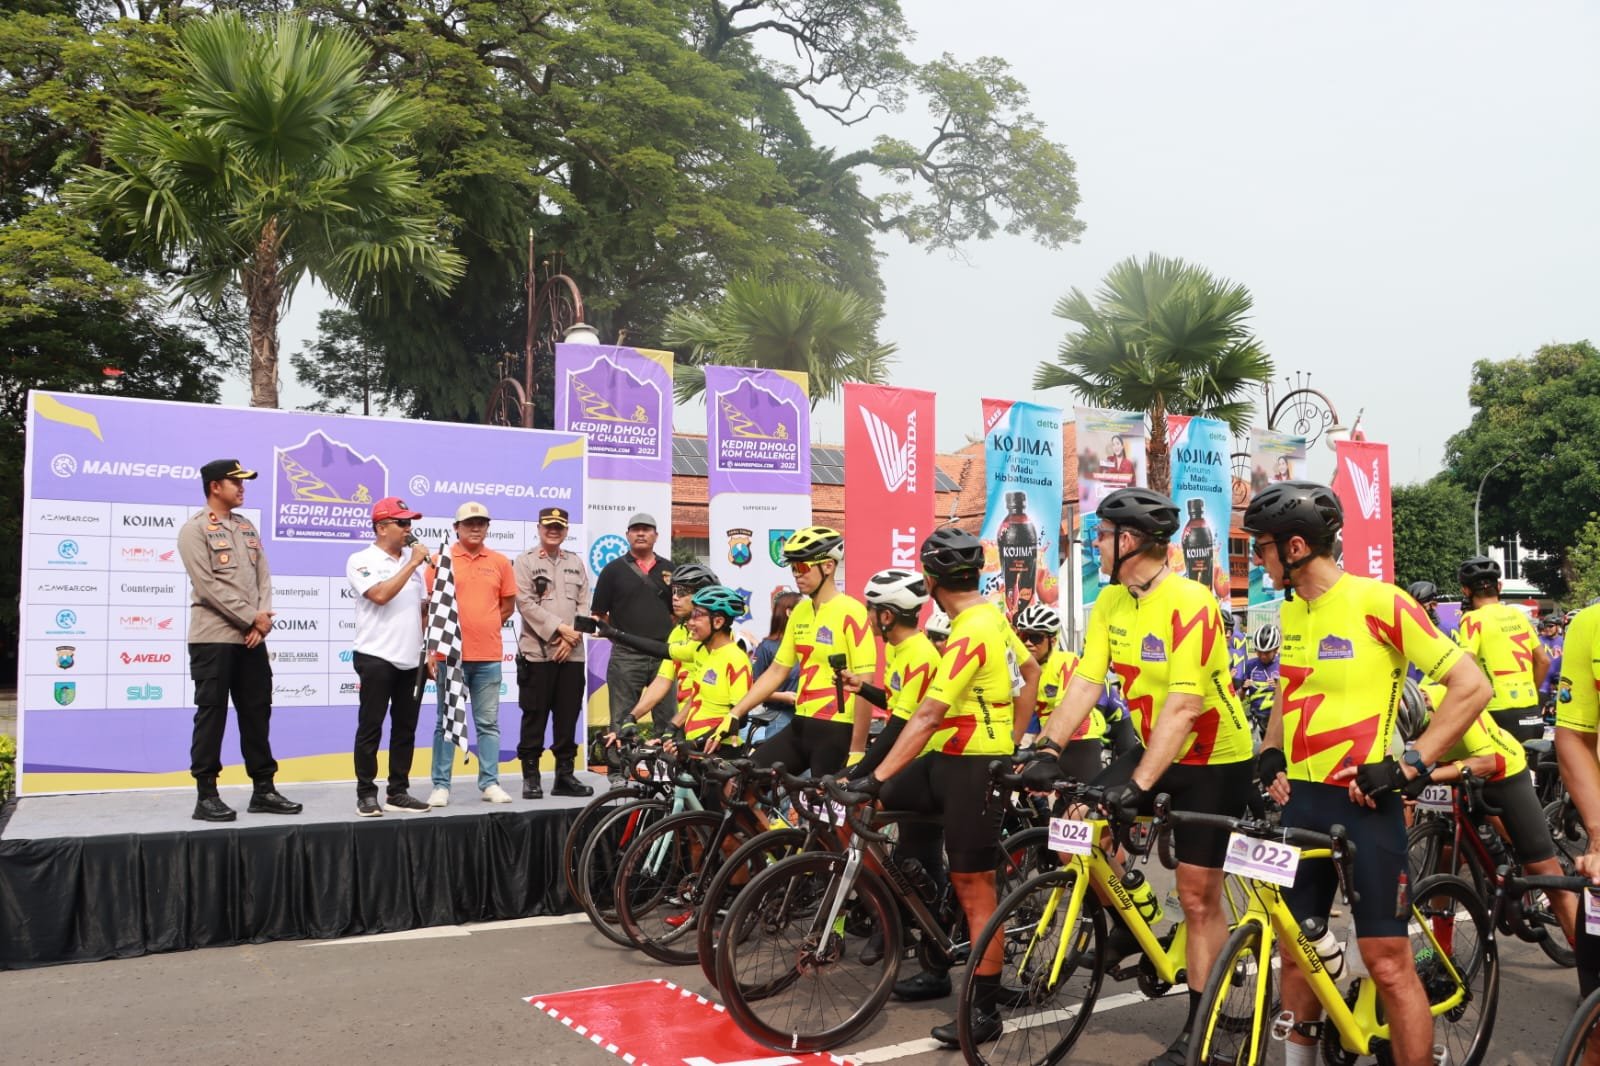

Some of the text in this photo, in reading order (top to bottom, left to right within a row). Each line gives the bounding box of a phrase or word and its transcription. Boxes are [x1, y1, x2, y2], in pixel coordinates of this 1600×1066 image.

[571, 422, 657, 437] KEDIRI DHOLO
[597, 434, 657, 446] CHALLENGE
[722, 440, 797, 453] KEDIRI DHOLO
[993, 434, 1053, 457] KOJIMA
[638, 447, 656, 455] 2022
[722, 450, 796, 460] KOM CHALLENGE
[907, 409, 917, 493] HONDA
[1177, 448, 1223, 466] KOJIMA
[434, 480, 572, 499] MAINSEPEDA.COM
[1372, 458, 1381, 520] HONDA
[280, 504, 371, 519] KEDIRI DHOL
[588, 504, 626, 512] PRESENTED
[123, 515, 175, 528] KOJIMA
[280, 515, 374, 528] KOM CHALLENG
[360, 531, 376, 539] 202
[892, 526, 917, 572] RT.
[1003, 546, 1033, 558] KOJIMA
[121, 583, 174, 595] Counterpain
[271, 620, 317, 630] KOJIMA
[132, 653, 171, 663] AVELIO
[1213, 678, 1242, 730] MAINSEPEDA.COM
[977, 695, 996, 740] MAINSEPEDA.COM
[1383, 681, 1399, 757] MAINSEPEDA.CO
[1424, 787, 1448, 801] 012
[1062, 824, 1089, 841] 024
[1252, 844, 1292, 869] 022
